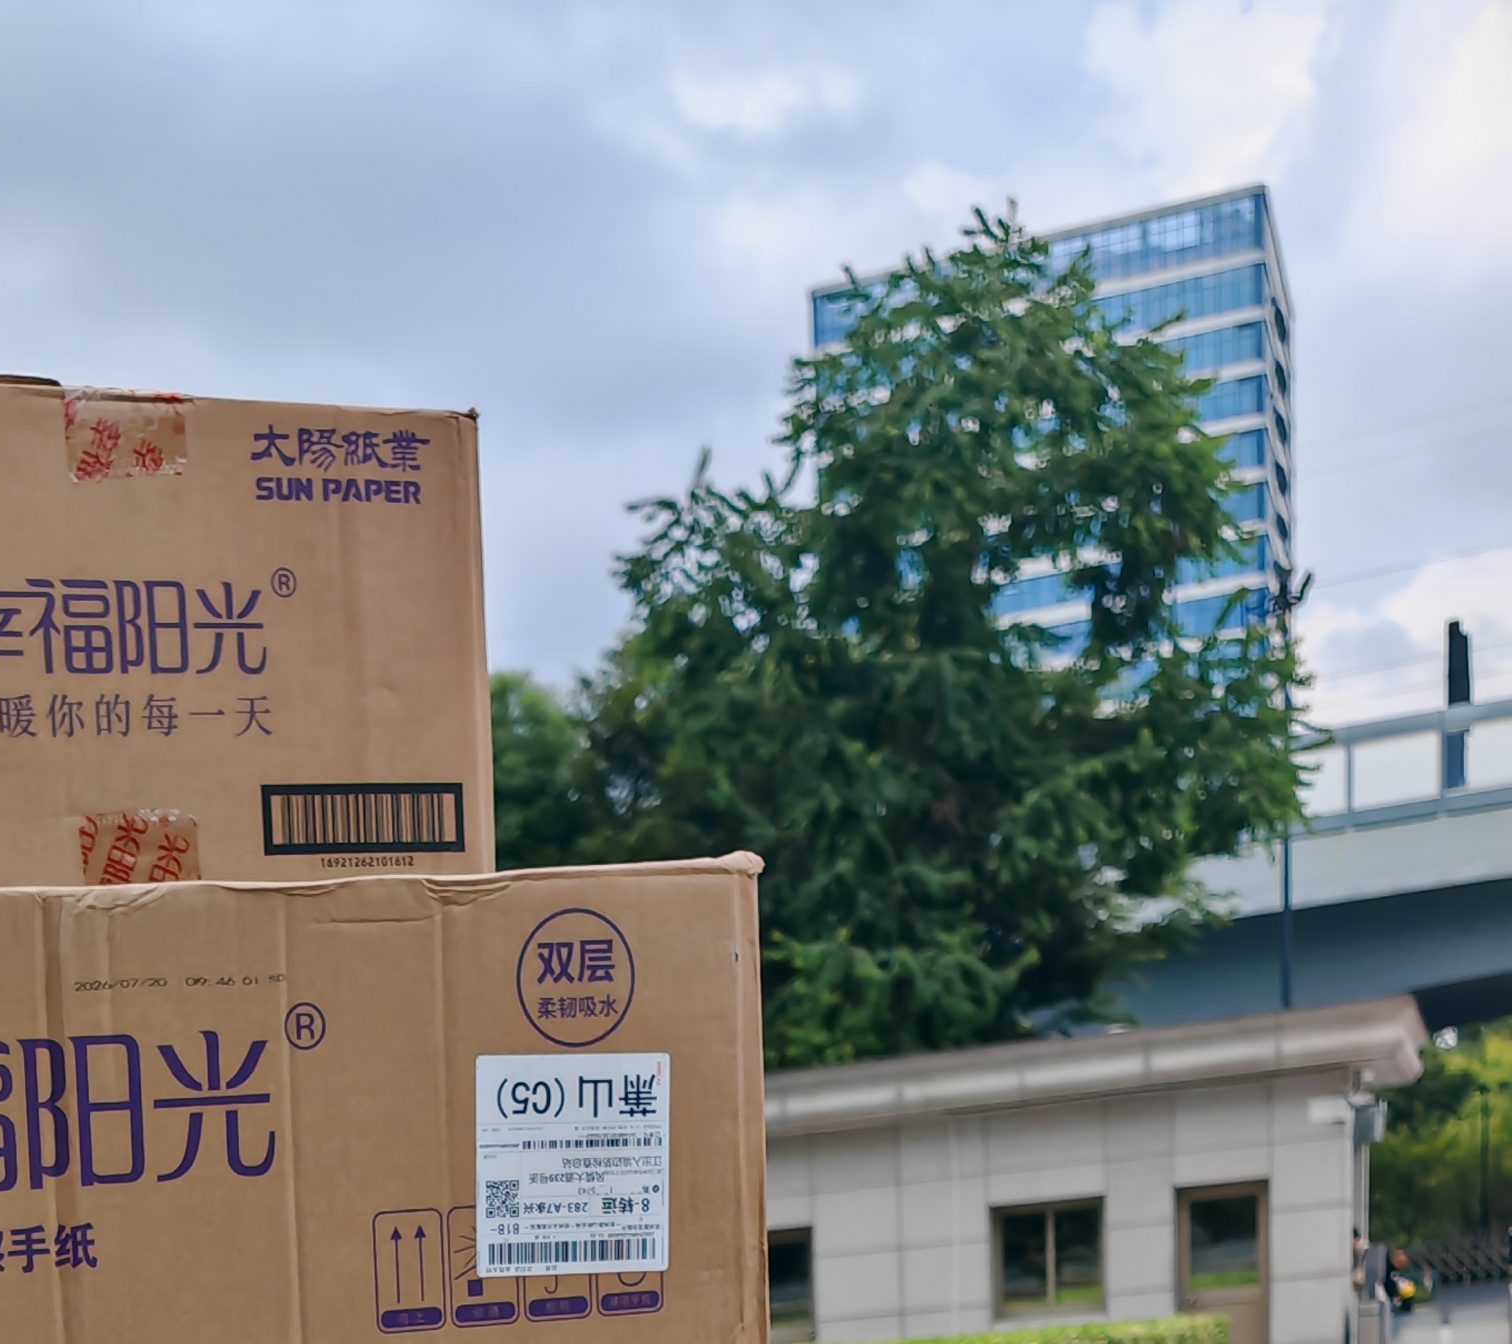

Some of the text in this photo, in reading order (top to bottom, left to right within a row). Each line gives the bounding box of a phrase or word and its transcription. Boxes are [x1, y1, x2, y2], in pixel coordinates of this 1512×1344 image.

[249, 422, 431, 474] 太陽紙業
[255, 477, 422, 505] SUN PAPER
[536, 939, 615, 986] 双层
[536, 996, 619, 1021] 柔韧吸水
[522, 1201, 588, 1215] 283-A7永兴
[601, 1196, 650, 1214] 8-转运
